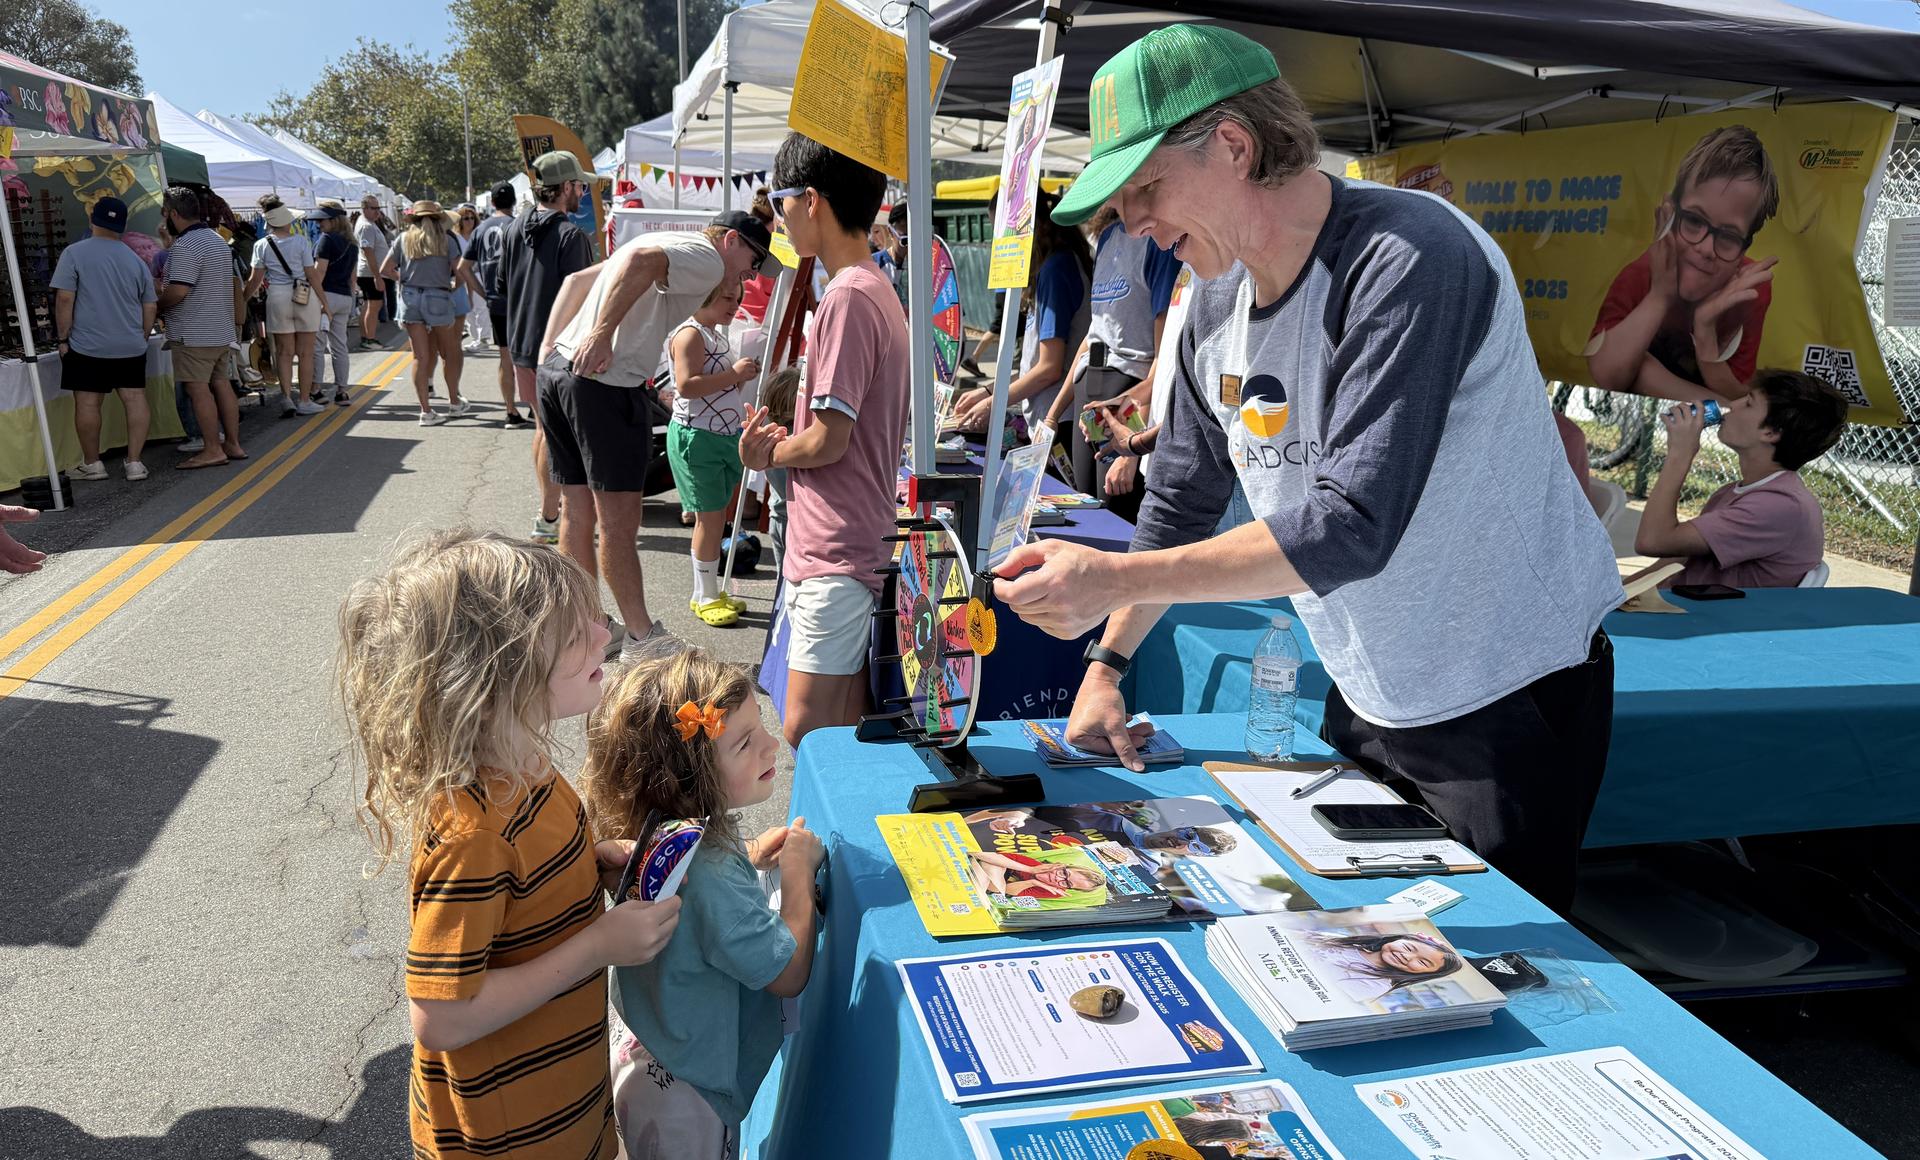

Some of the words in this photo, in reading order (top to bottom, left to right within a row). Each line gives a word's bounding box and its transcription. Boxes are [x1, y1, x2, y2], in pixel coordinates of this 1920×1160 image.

[18, 86, 42, 112] PSC
[1465, 180, 1518, 204] WALK
[1526, 178, 1552, 201] TO
[1559, 174, 1623, 200] MAKE
[1482, 206, 1609, 234] DIFFERENCE!
[1524, 279, 1568, 299] 2025
[999, 688, 1069, 720] RIEND
[1141, 951, 1160, 965] HOW
[1153, 966, 1167, 975] TO
[1265, 925, 1286, 945] ANNUAL
[1279, 947, 1302, 968] REPORT
[1298, 973, 1321, 990] HONOR
[1313, 990, 1332, 1003] ROLL
[1131, 952, 1148, 963] FOR
[1140, 964, 1158, 977] THE
[1150, 977, 1171, 996] WALK
[1133, 972, 1155, 994] OCTOBER
[1159, 975, 1190, 1006] REGISTER
[1642, 1087, 1662, 1098] Our
[1656, 1099, 1685, 1117] Guest
[1676, 1117, 1720, 1145] Program
[1288, 1137, 1312, 1159] OPENS
[1292, 1128, 1311, 1143] New
